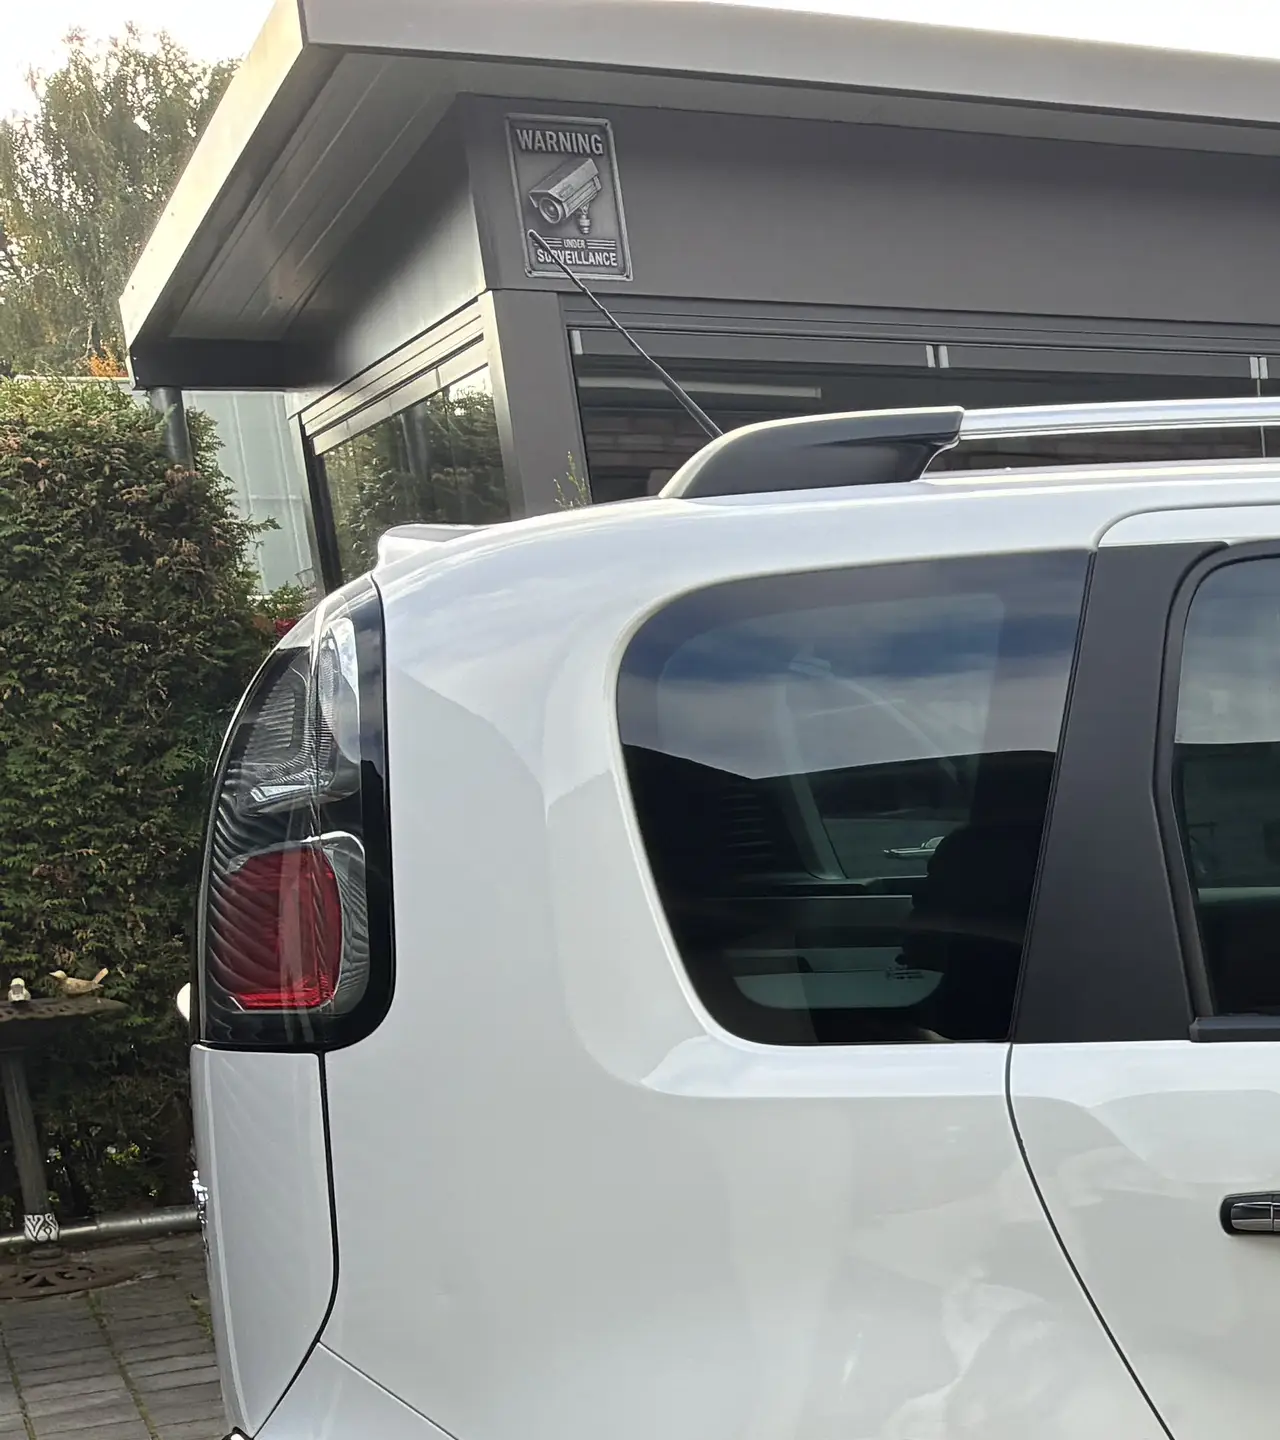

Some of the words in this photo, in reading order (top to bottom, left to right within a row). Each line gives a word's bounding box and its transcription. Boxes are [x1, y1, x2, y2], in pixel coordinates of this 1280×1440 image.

[516, 128, 604, 155] WARNING
[563, 238, 586, 249] UNDER
[536, 248, 618, 267] SURVEILLANCE
